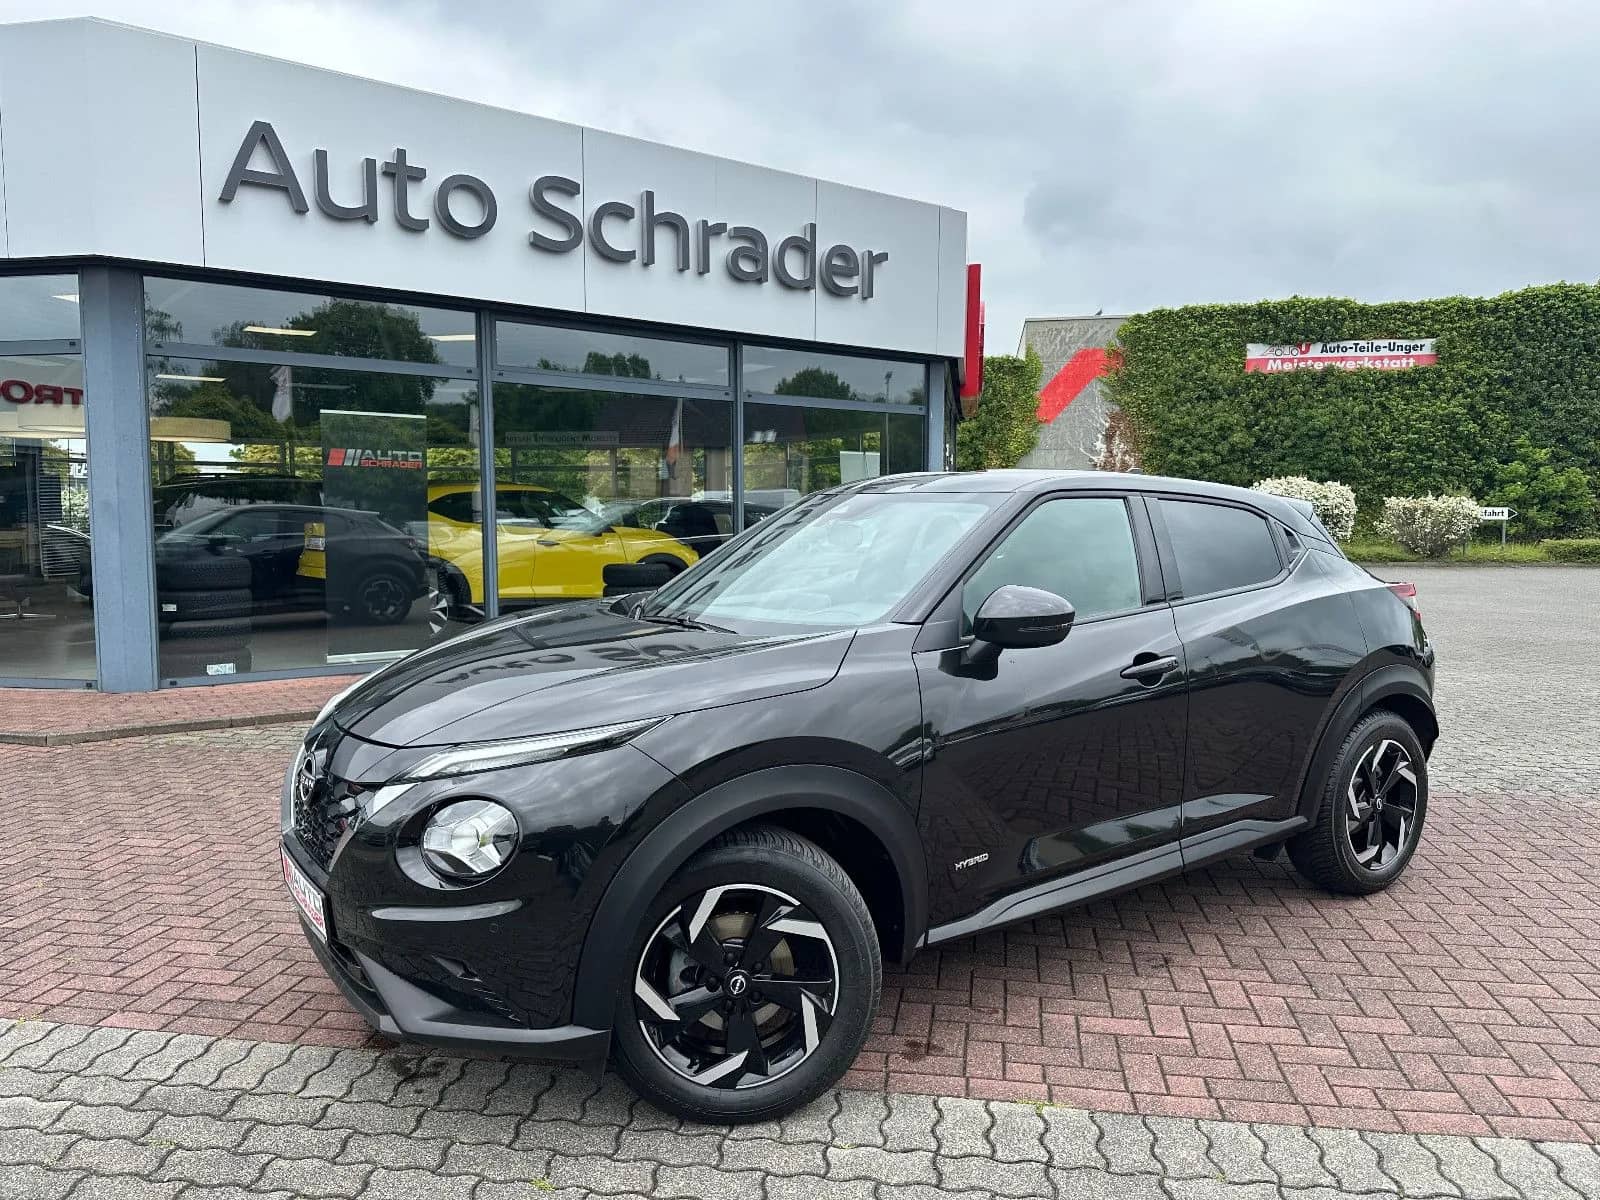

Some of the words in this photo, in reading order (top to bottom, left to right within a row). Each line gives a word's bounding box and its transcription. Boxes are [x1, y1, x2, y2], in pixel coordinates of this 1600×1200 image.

[218, 120, 498, 239] Auto
[529, 175, 889, 299] Schrader
[1320, 342, 1425, 354] Auto-Teile-Unger
[361, 449, 423, 461] AUTO
[360, 459, 423, 470] SCHRADER
[954, 852, 989, 870] HYBRID
